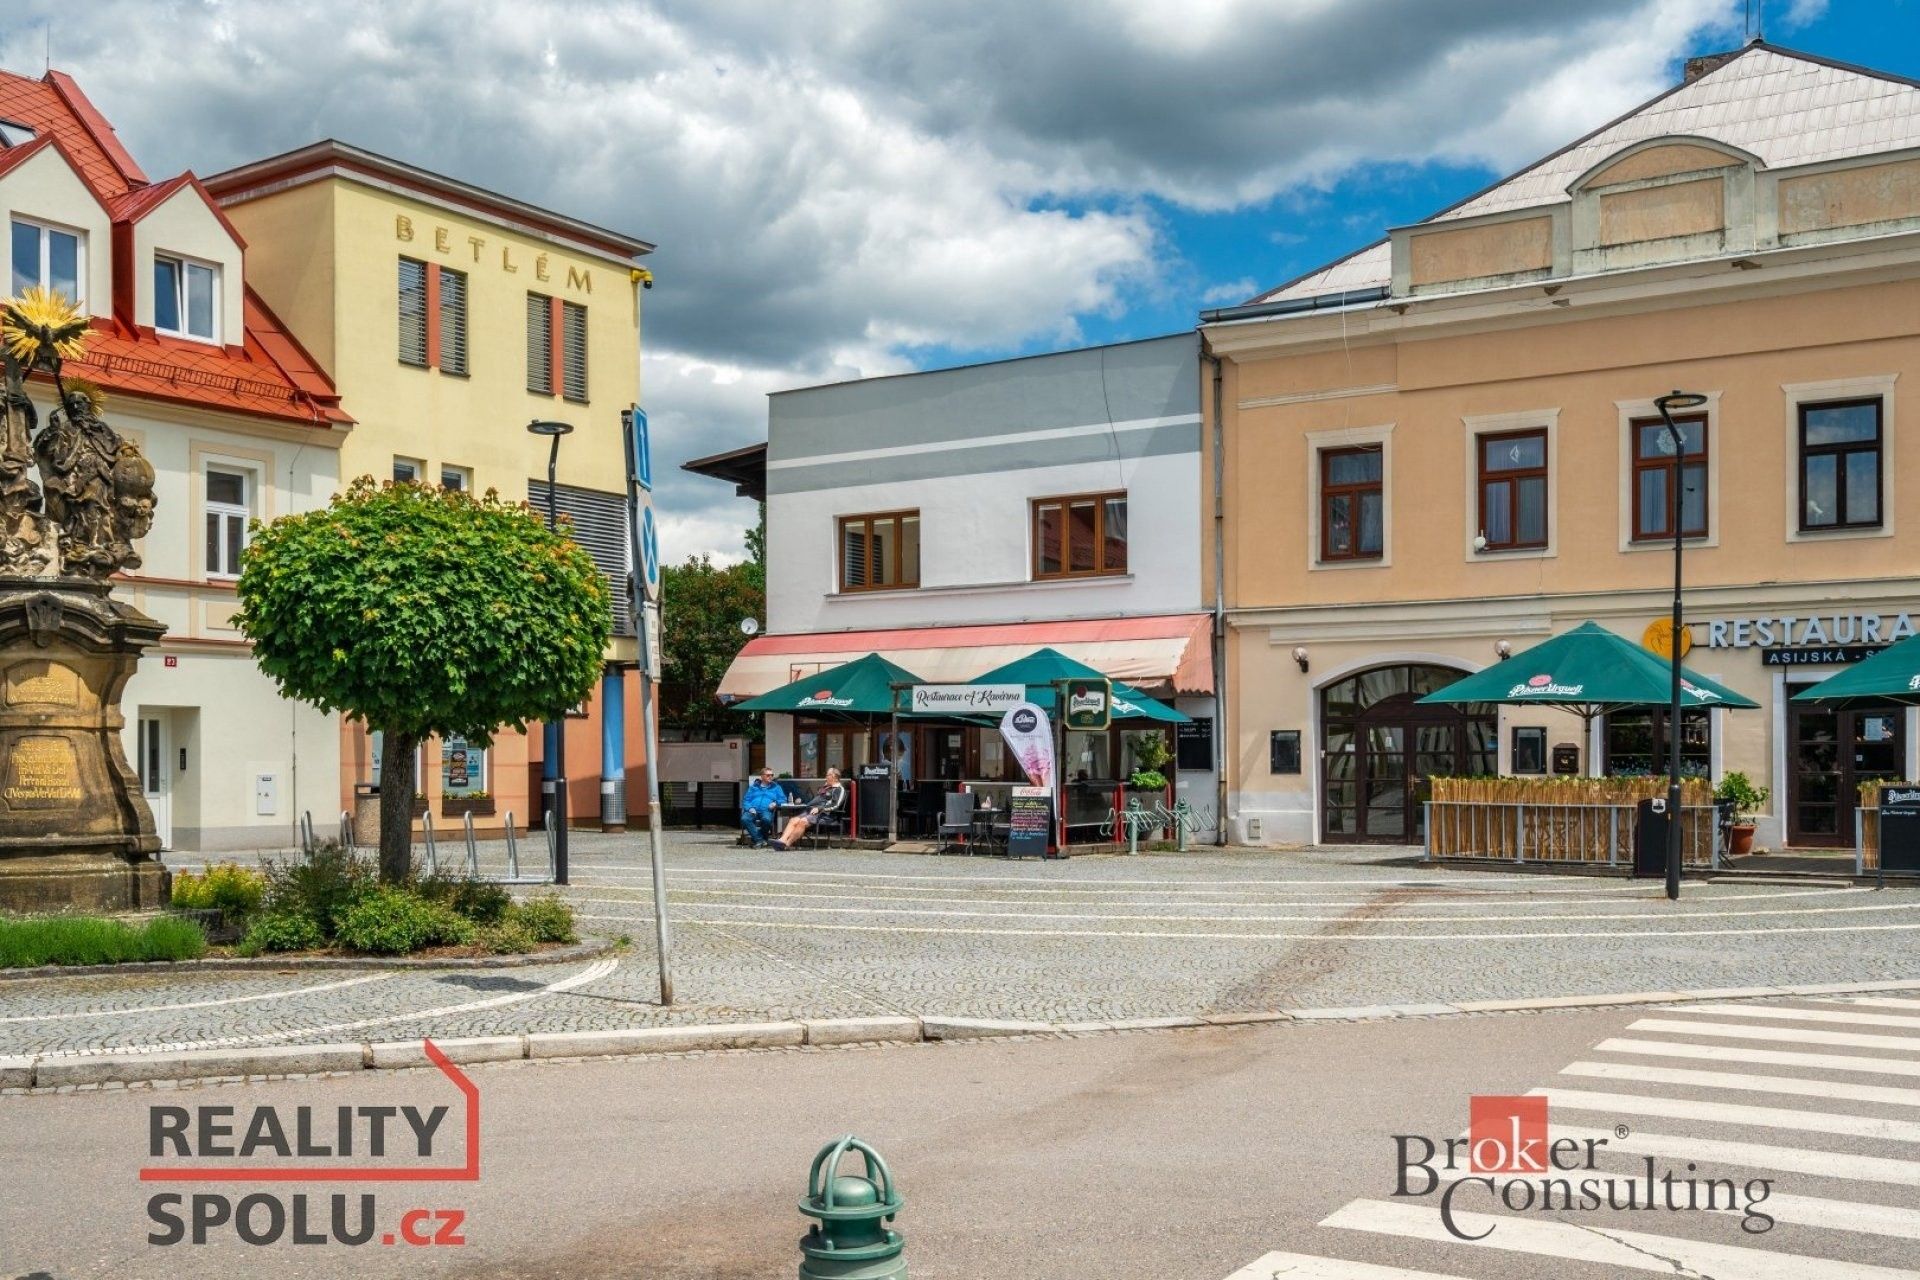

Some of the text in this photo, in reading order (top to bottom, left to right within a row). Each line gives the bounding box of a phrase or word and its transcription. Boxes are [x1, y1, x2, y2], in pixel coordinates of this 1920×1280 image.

[396, 214, 592, 295] BETLÉM
[1769, 649, 1846, 664] ASIJSKÁ
[916, 689, 962, 707] Restaurace
[1507, 683, 1583, 698] Pilsner Urquell
